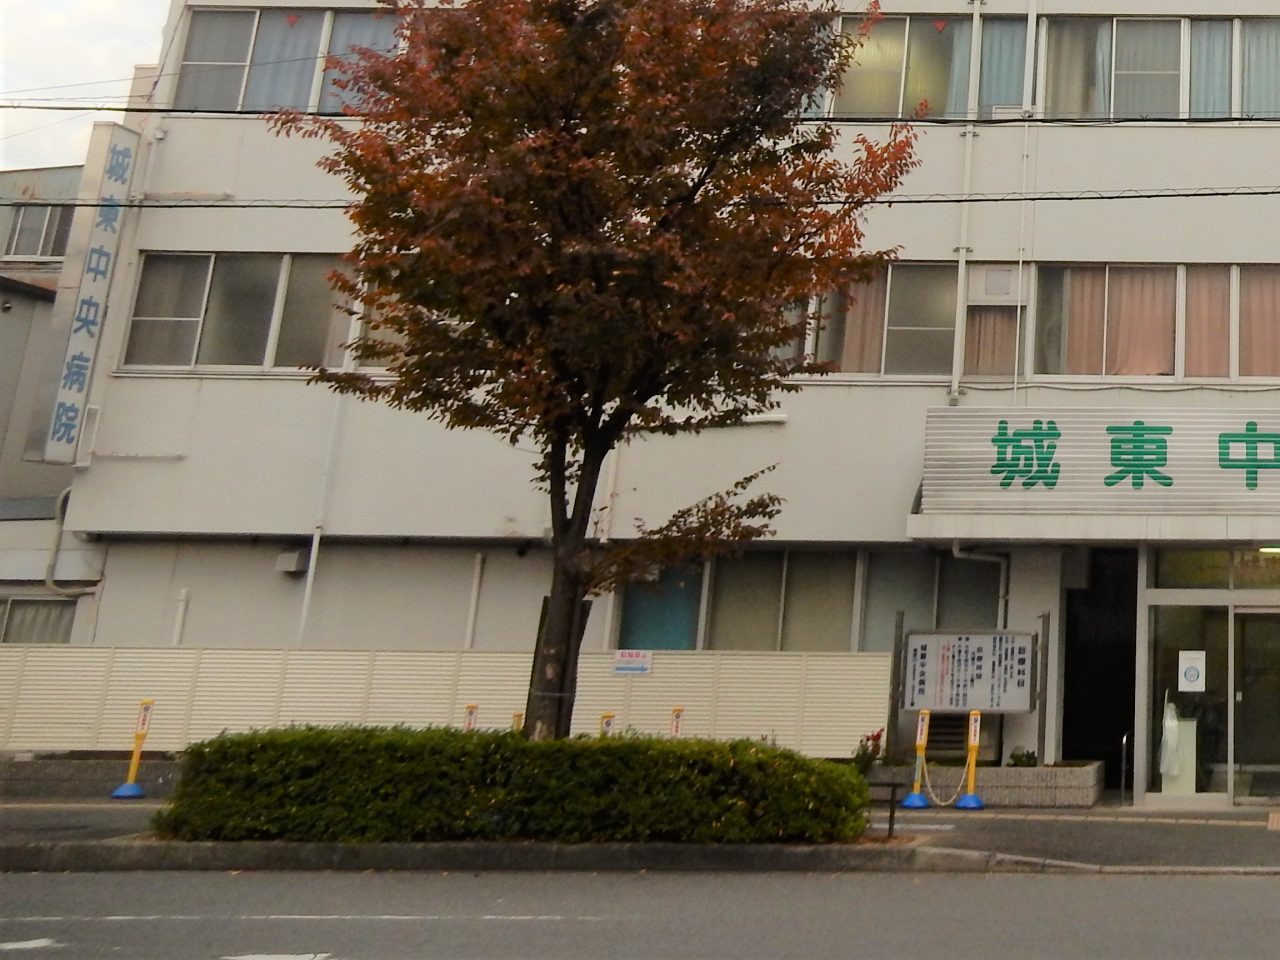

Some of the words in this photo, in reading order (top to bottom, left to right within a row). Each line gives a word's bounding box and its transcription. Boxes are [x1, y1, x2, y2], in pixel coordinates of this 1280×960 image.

[51, 143, 132, 445] 城東中央病院
